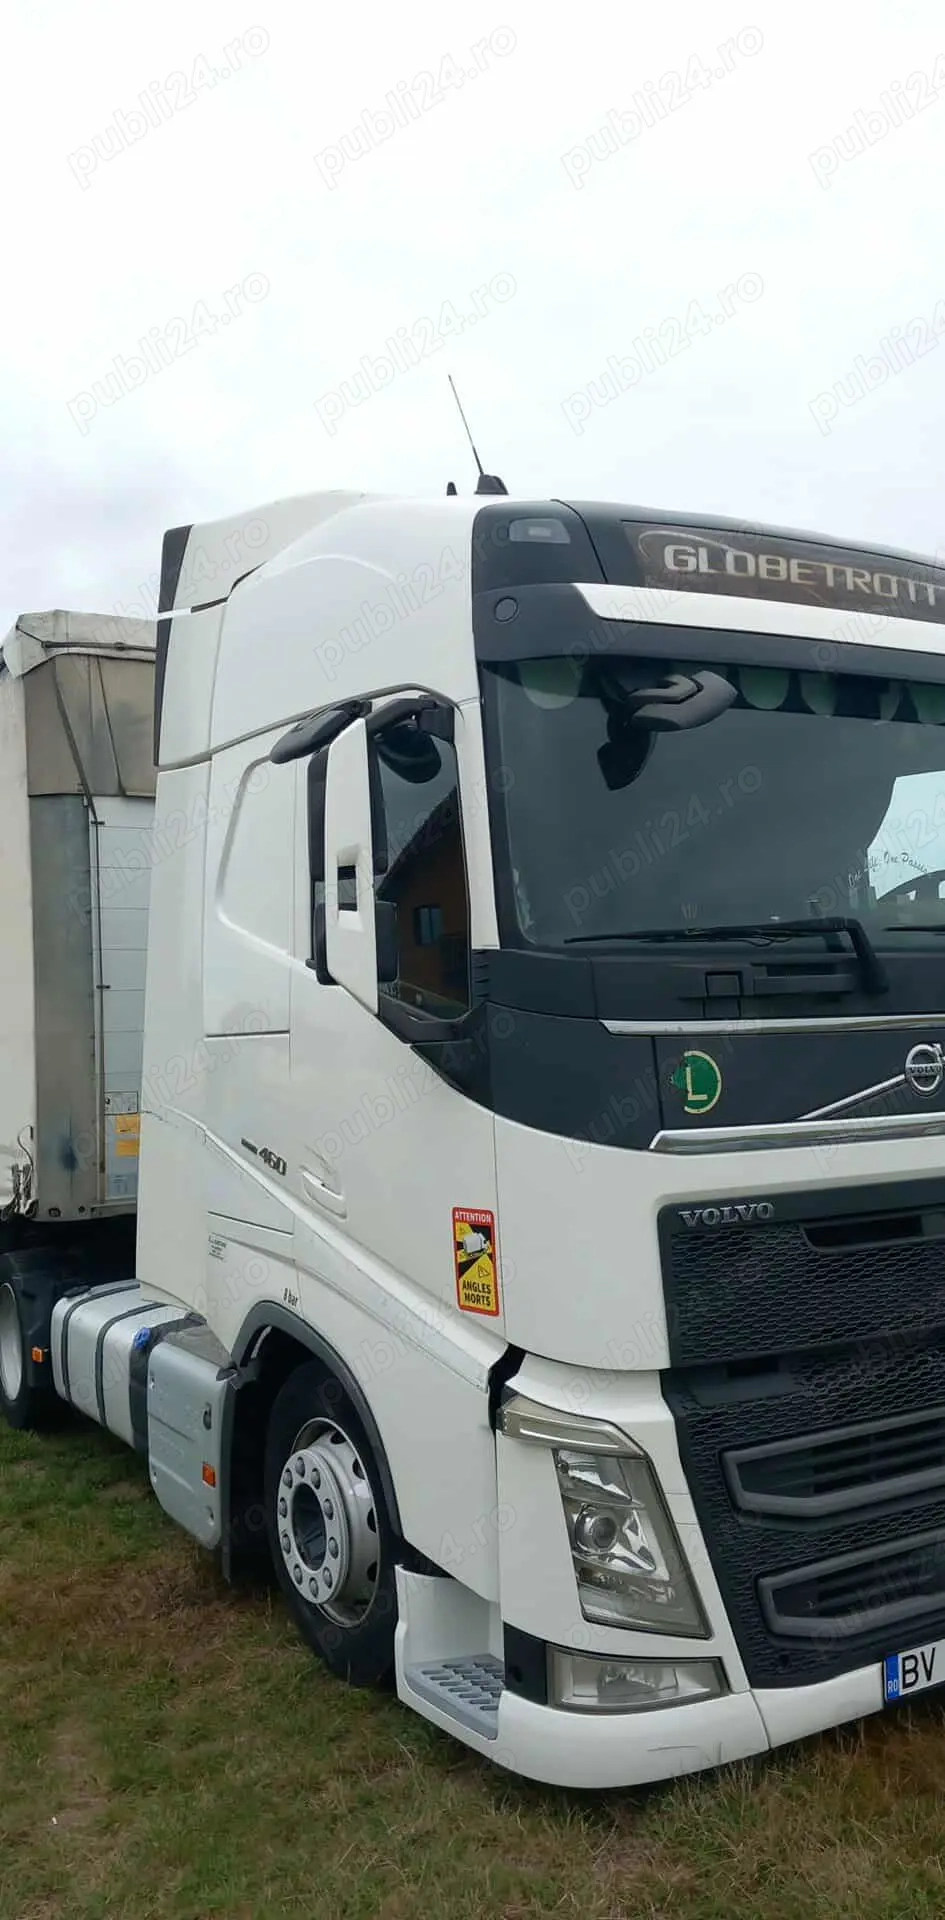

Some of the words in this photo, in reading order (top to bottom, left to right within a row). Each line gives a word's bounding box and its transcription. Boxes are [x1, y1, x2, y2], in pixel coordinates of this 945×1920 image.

[259, 1147, 287, 1177] 460
[454, 1210, 492, 1224] ATTENTION
[678, 1202, 775, 1229] VOLVO
[462, 1279, 491, 1295] ANGLES
[463, 1292, 491, 1307] MORTS
[902, 1646, 937, 1690] BV
[887, 1679, 898, 1694] RO
